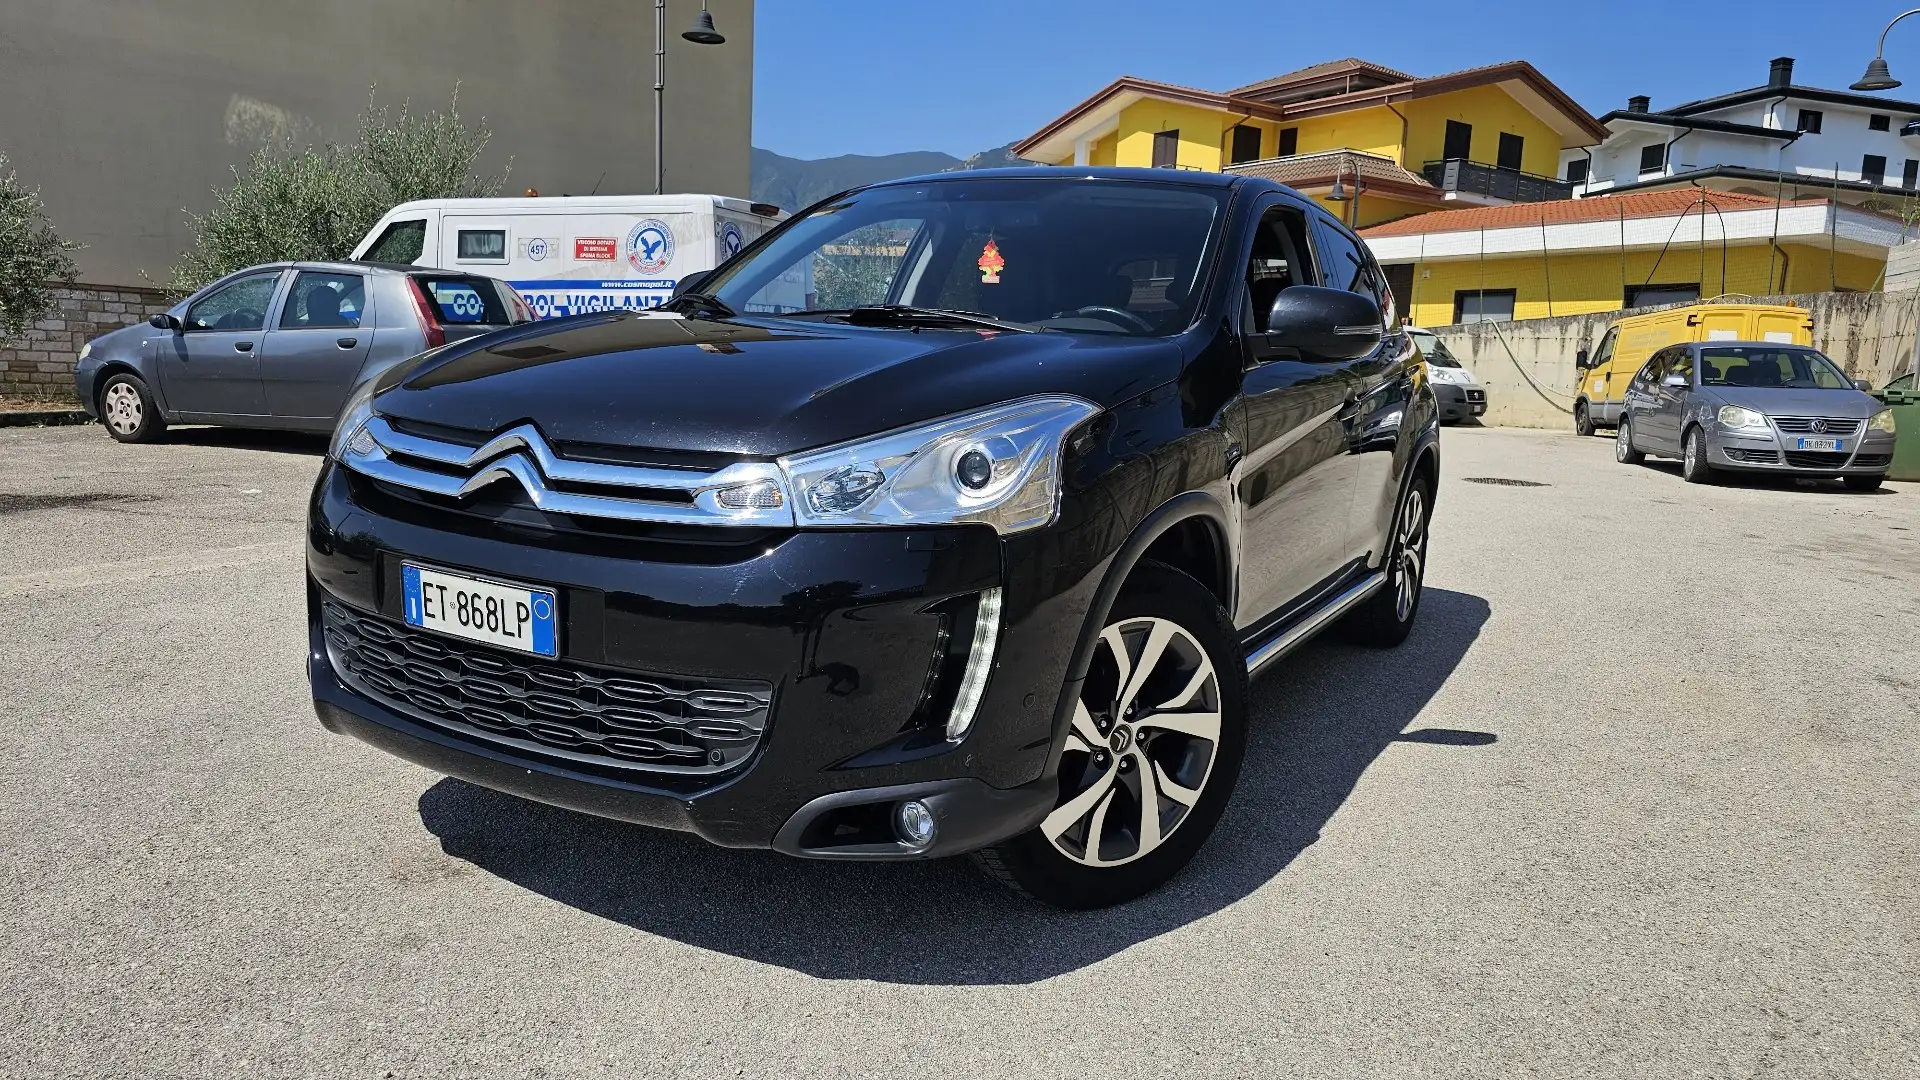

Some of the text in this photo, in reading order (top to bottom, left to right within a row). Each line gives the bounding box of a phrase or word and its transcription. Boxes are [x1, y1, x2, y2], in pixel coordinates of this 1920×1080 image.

[530, 245, 544, 254] 457
[601, 280, 672, 289] www.cosmopol.it
[422, 581, 530, 639] ET 868LP
